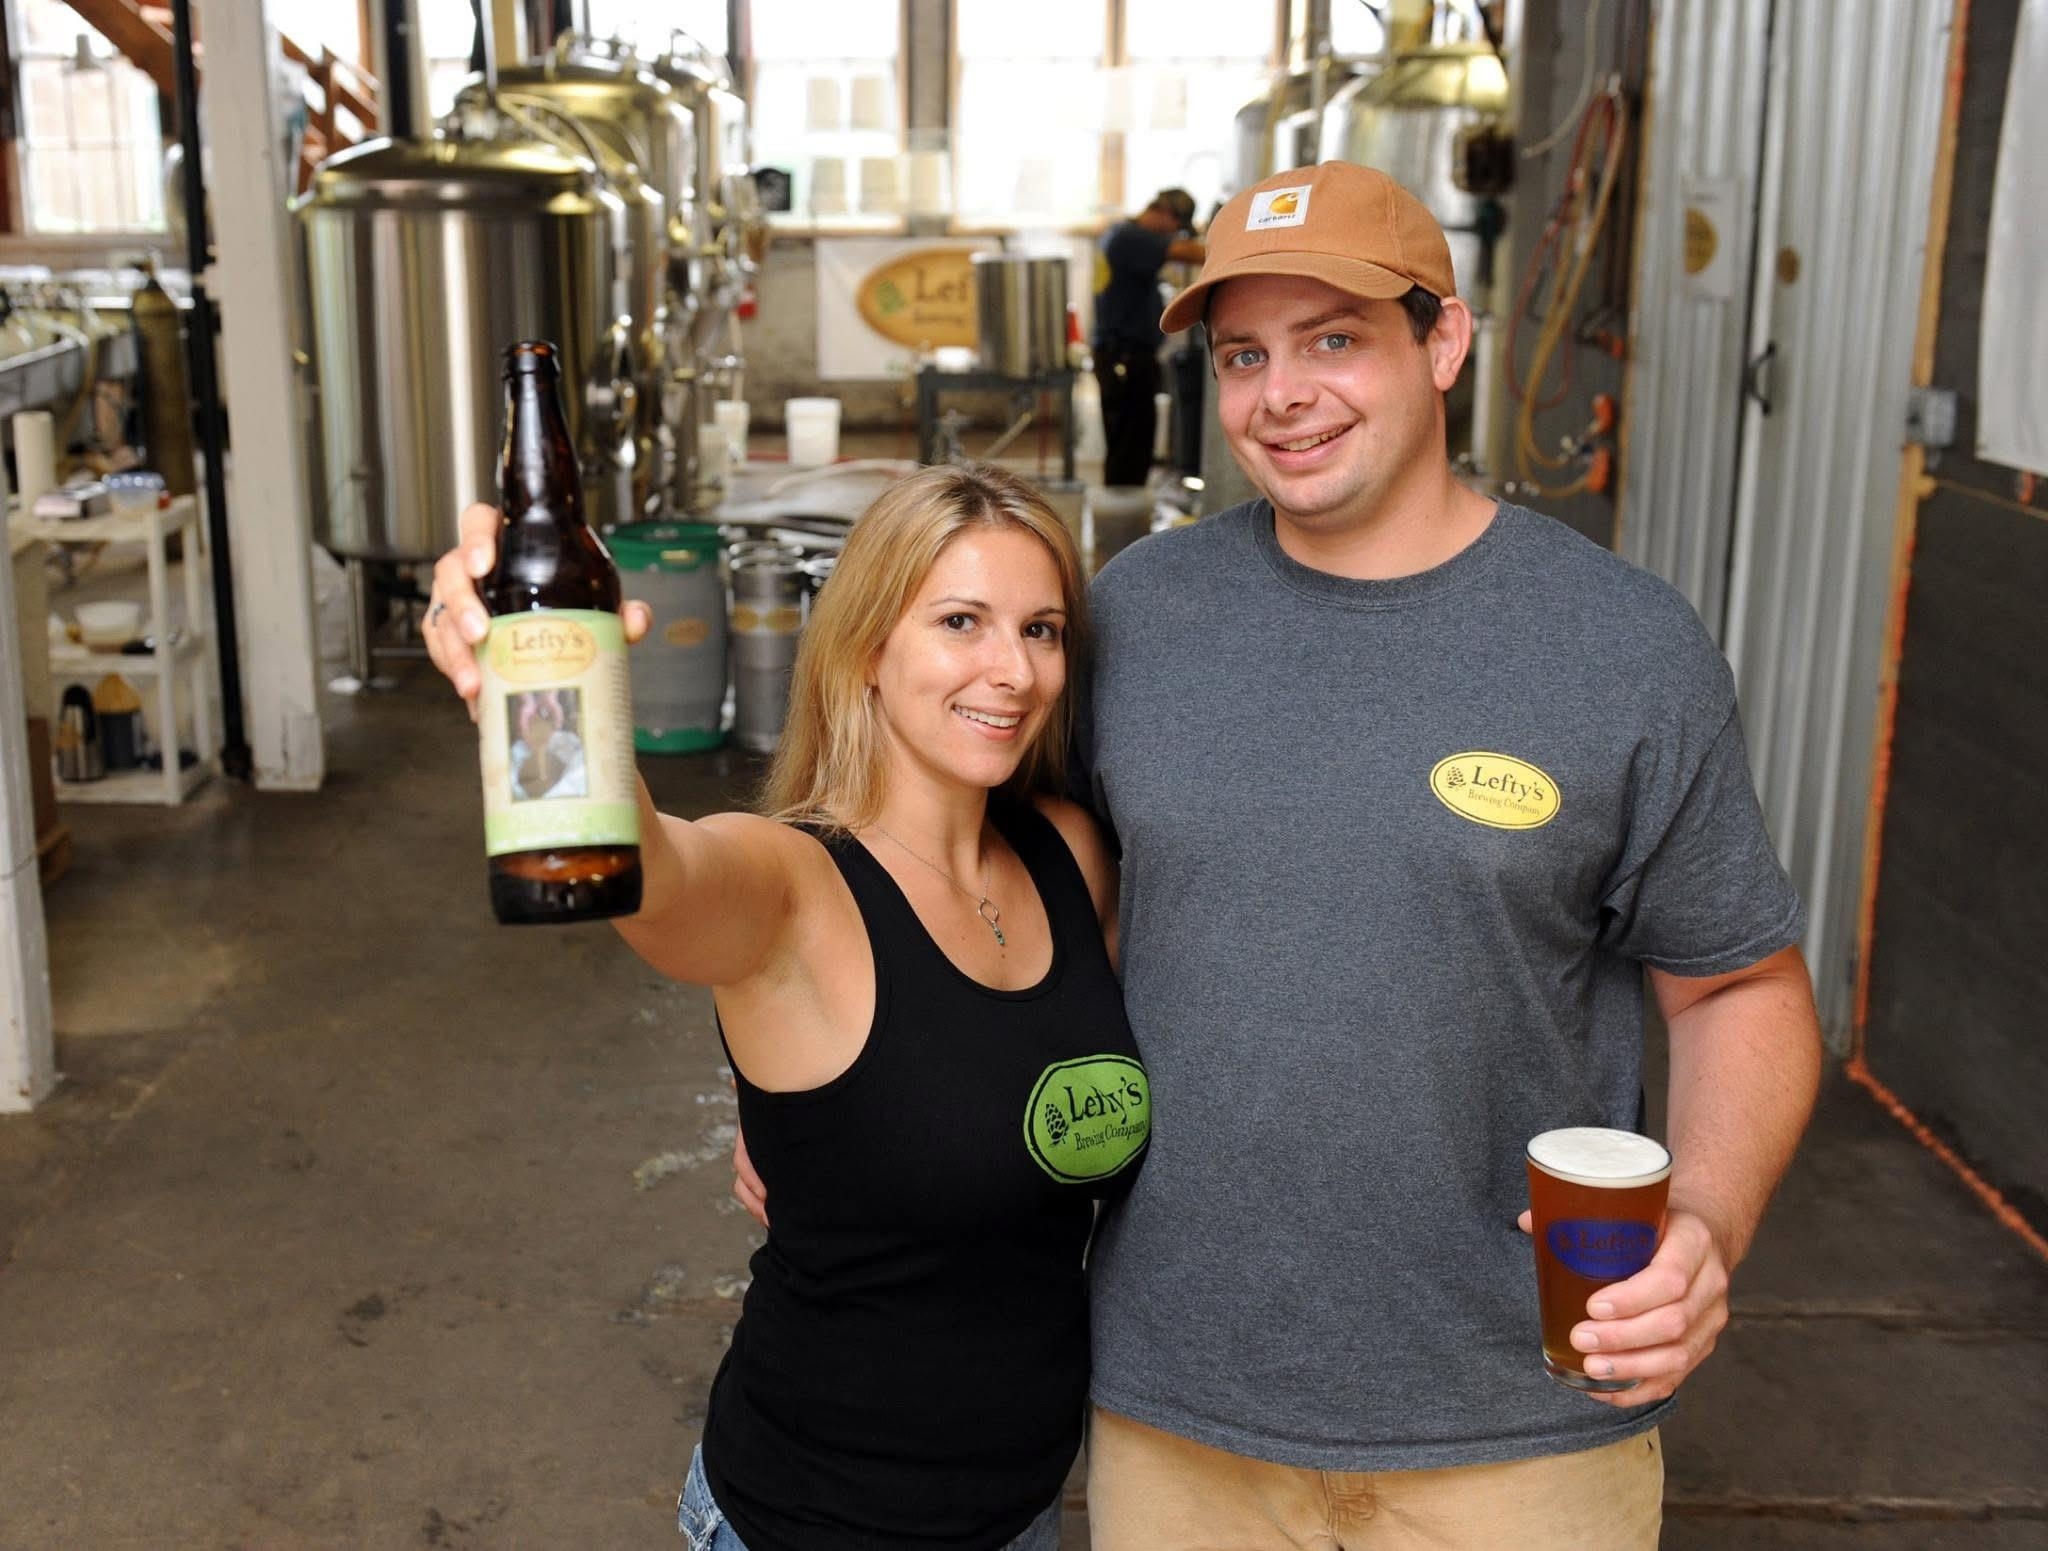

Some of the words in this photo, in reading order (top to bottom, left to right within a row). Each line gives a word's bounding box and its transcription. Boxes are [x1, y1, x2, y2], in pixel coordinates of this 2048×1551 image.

[512, 627, 586, 652] Lefty's
[1471, 766, 1545, 802] Lefty's
[1467, 788, 1503, 808] Brewing
[1503, 798, 1541, 816] Company
[1073, 1129, 1106, 1151] Brewing
